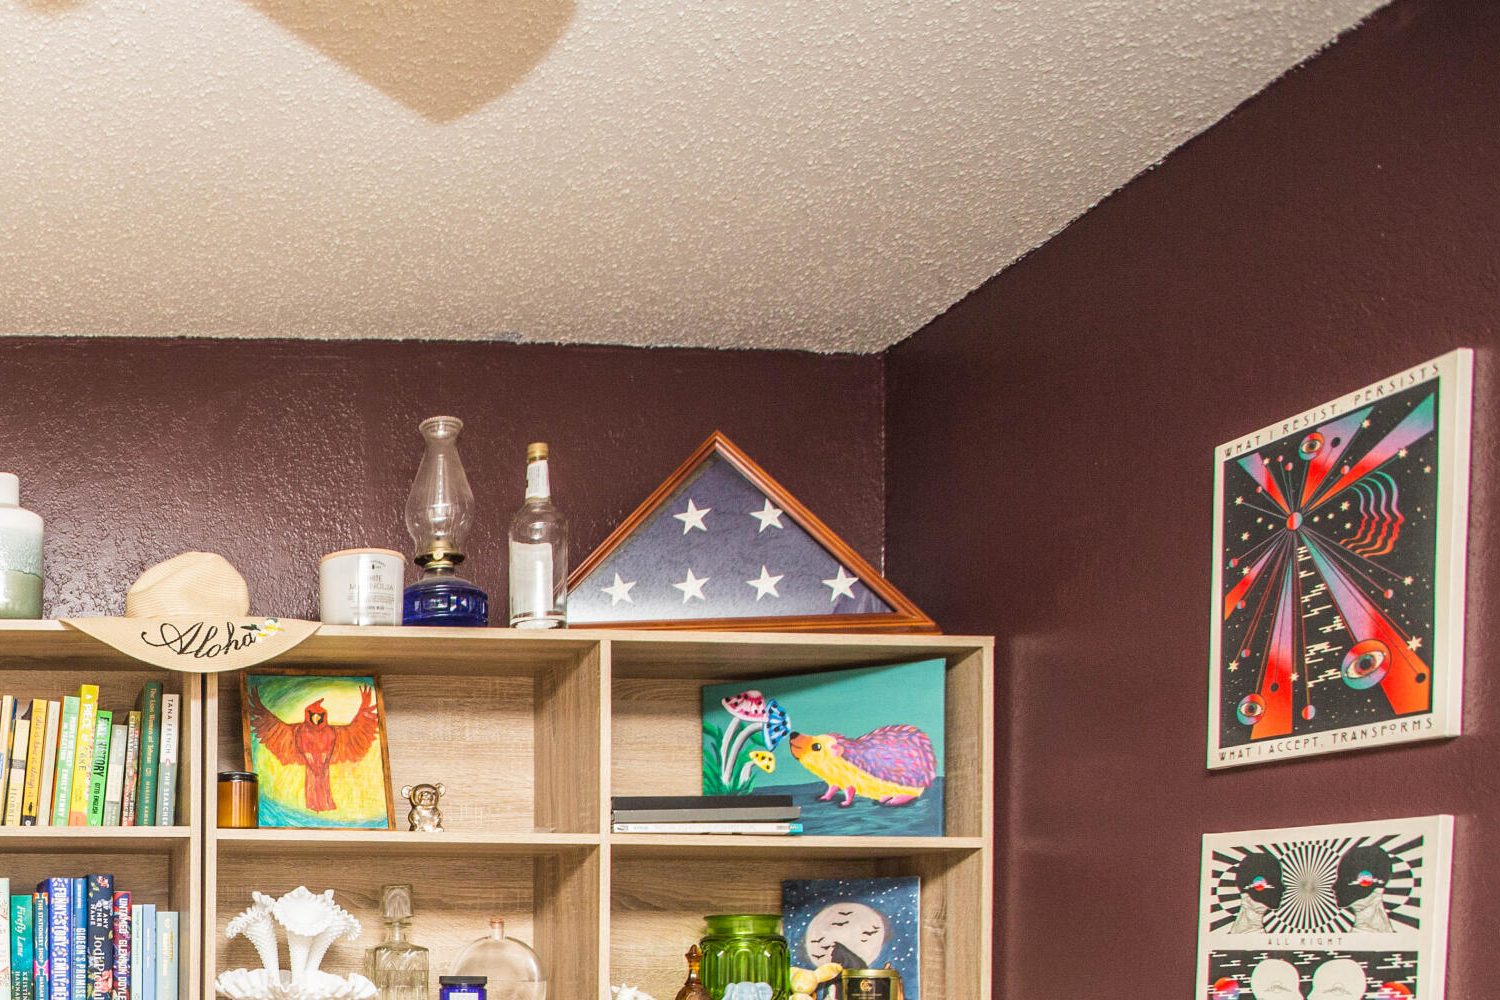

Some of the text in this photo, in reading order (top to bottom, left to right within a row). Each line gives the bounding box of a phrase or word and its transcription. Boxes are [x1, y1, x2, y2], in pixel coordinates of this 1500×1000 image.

[1224, 435, 1261, 457] WHAT
[1353, 363, 1439, 405] PERSISTS
[141, 622, 257, 658] Aloha
[97, 716, 110, 739] FAKE
[165, 723, 173, 755] FRENCH
[1218, 748, 1251, 762] WHAT
[1332, 718, 1433, 745] TRANSFORMS
[93, 739, 108, 778] HISTORY
[92, 795, 100, 815] ENGLISH
[53, 887, 67, 917] FUNNY
[14, 905, 27, 958] Firefly Lane
[53, 919, 67, 948] STORY
[92, 935, 106, 957] Jodi
[1267, 937, 1343, 946] ALL RIGHT
[53, 957, 67, 983] EMILY
[74, 927, 87, 999] GIDEON'S PROMISE
